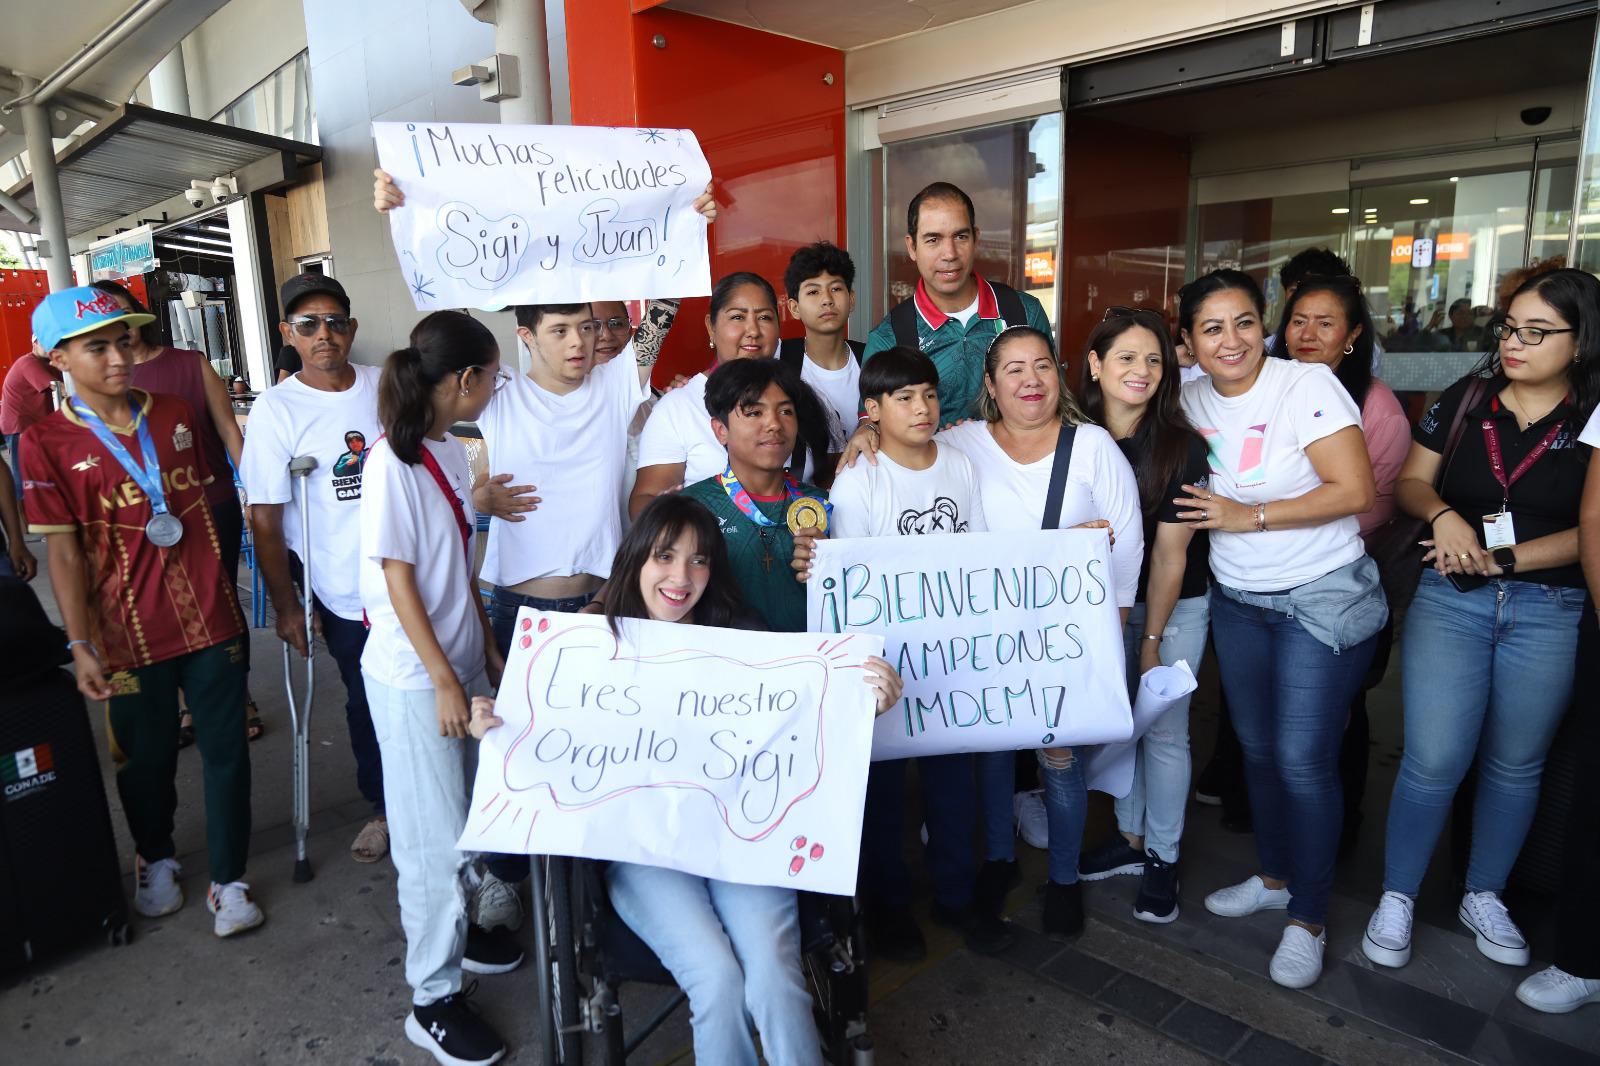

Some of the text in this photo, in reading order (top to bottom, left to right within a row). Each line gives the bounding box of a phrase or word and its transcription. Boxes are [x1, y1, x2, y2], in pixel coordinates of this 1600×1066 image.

[407, 123, 554, 177] ¡Muchas
[446, 203, 672, 282] Sigi y Juan!
[98, 464, 215, 511] MÉICO
[819, 558, 1107, 633] ¡BIENVENIDOS
[545, 645, 797, 718] Eres nuestro
[882, 622, 1084, 681] AMPEONES
[904, 678, 1066, 745] IMDEM!
[4, 770, 57, 796] CONADE
[535, 727, 798, 824] Orgullo Sigi
